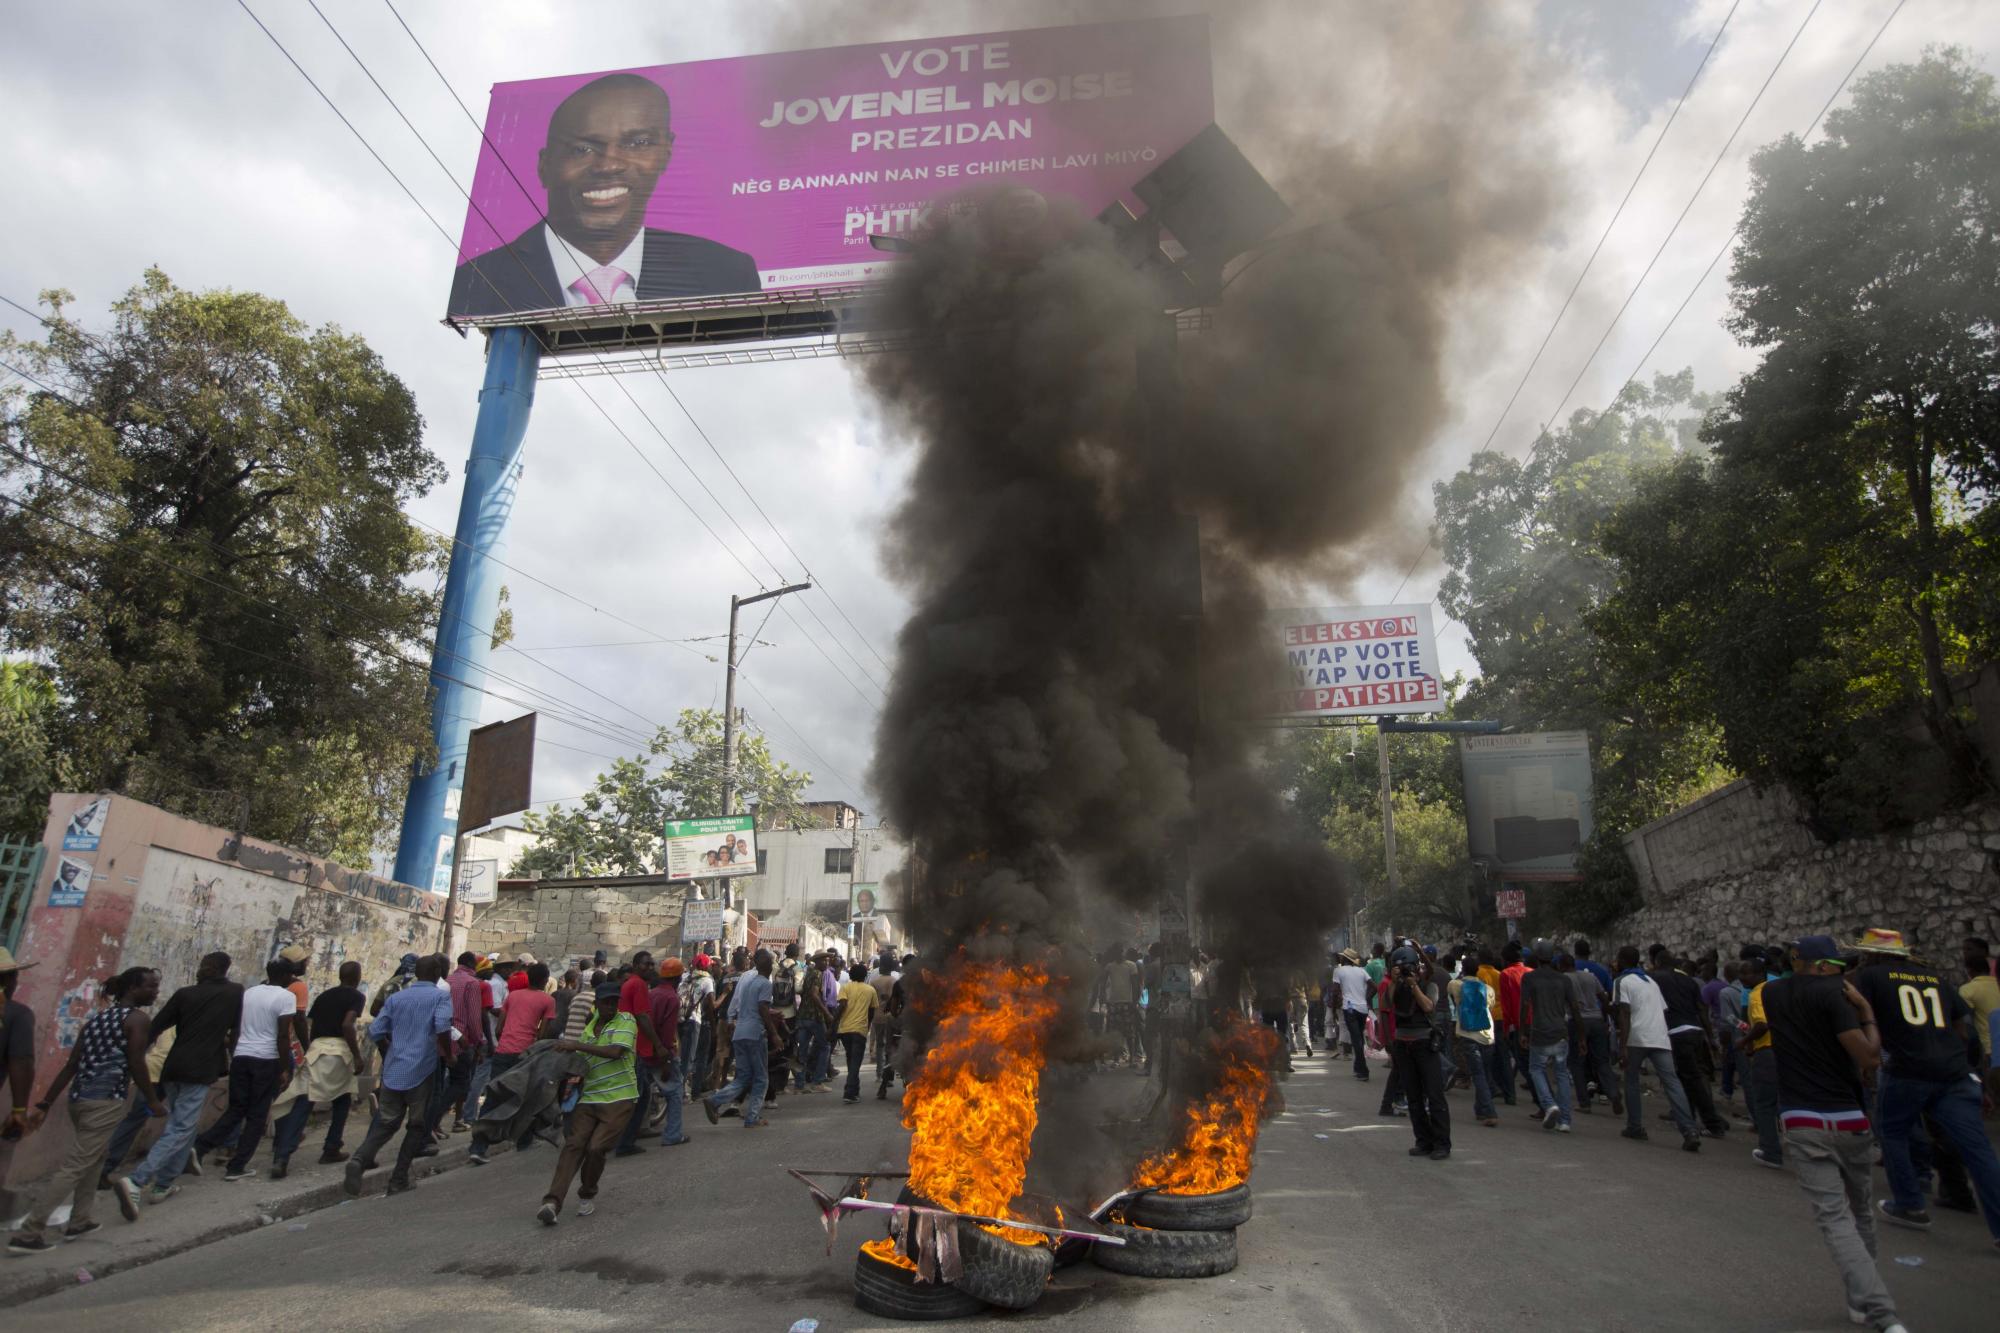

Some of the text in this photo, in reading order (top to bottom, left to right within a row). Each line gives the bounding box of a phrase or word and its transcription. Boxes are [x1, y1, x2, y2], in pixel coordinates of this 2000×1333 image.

[879, 41, 1011, 79] VOTE
[759, 69, 1133, 128] JOVENEL MOISE
[850, 117, 1033, 153] PREZIDAN
[731, 146, 1158, 196] NÈG BANNANN NAN SE CHIMEN LAVI MIYÒ
[844, 207, 933, 236] PHTK
[843, 236, 864, 246] Parti
[1286, 617, 1417, 645] ELEKSYON
[1288, 639, 1420, 667] M'AP VOTE
[1355, 660, 1421, 682] VOTE
[1314, 680, 1438, 709] PATISIPE
[1898, 984, 1945, 1027] 01
